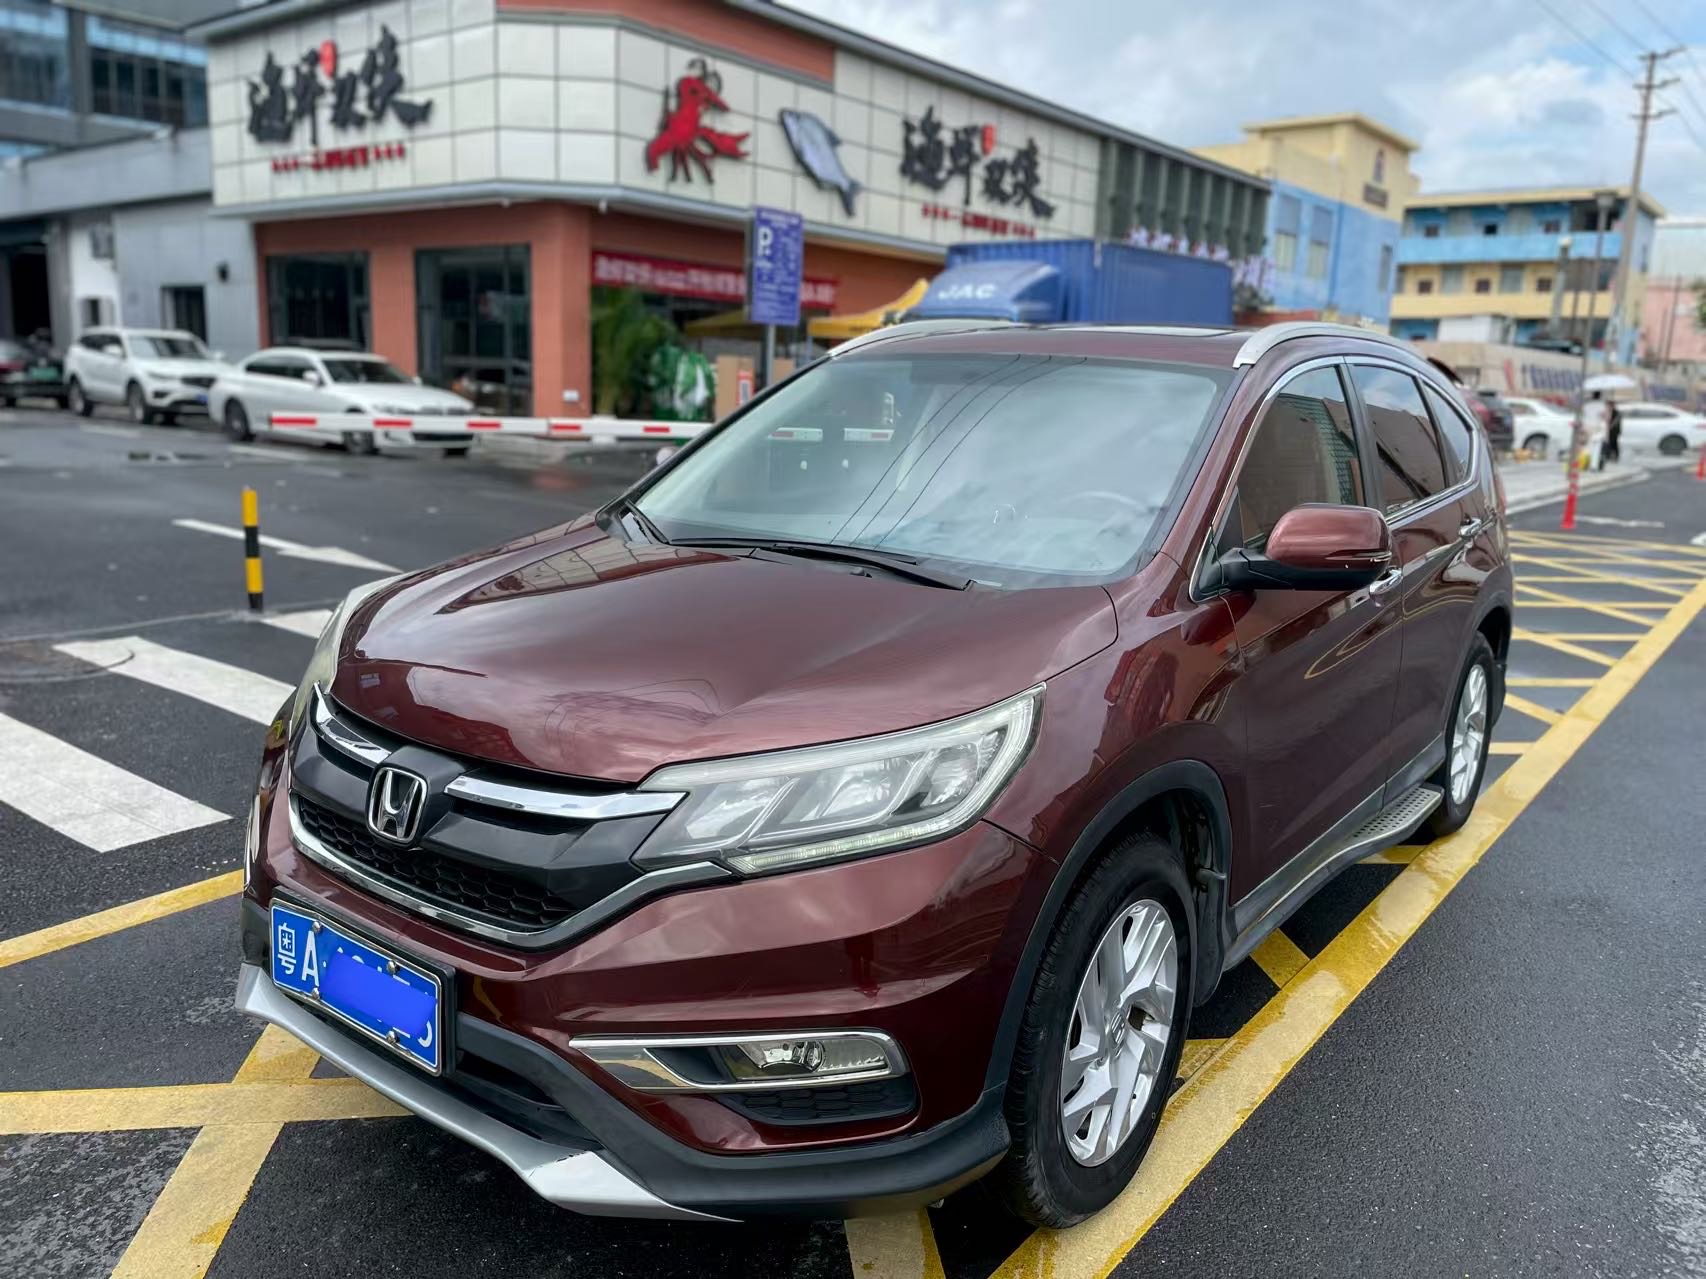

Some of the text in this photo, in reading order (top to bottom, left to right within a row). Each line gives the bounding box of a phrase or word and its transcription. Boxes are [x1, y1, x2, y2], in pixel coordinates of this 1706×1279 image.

[757, 226, 774, 257] P
[937, 283, 995, 299] JAC
[277, 922, 320, 987] 粤A
